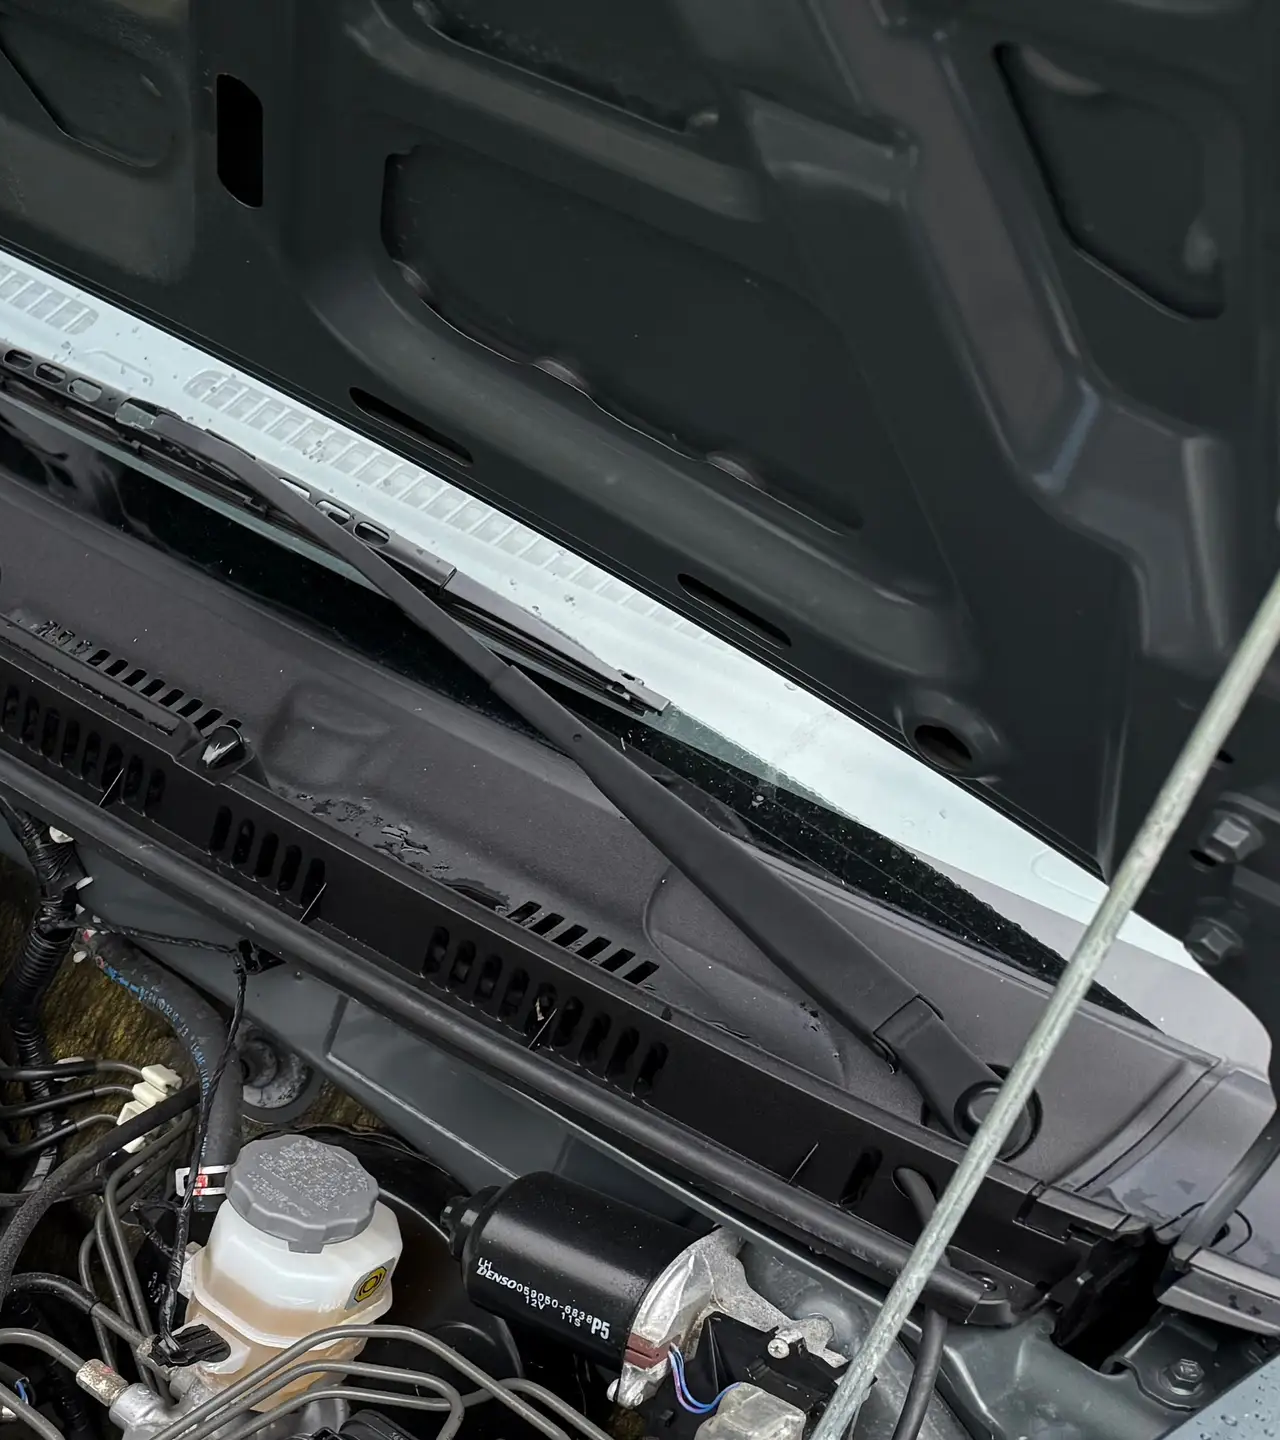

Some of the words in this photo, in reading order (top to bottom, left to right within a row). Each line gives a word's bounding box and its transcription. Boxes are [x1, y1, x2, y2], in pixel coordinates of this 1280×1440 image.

[478, 1257, 492, 1270] LH
[476, 1265, 517, 1289] DENSO
[516, 1283, 593, 1325] 059050-6838
[590, 1317, 611, 1340] P5
[525, 1295, 546, 1310] 12V
